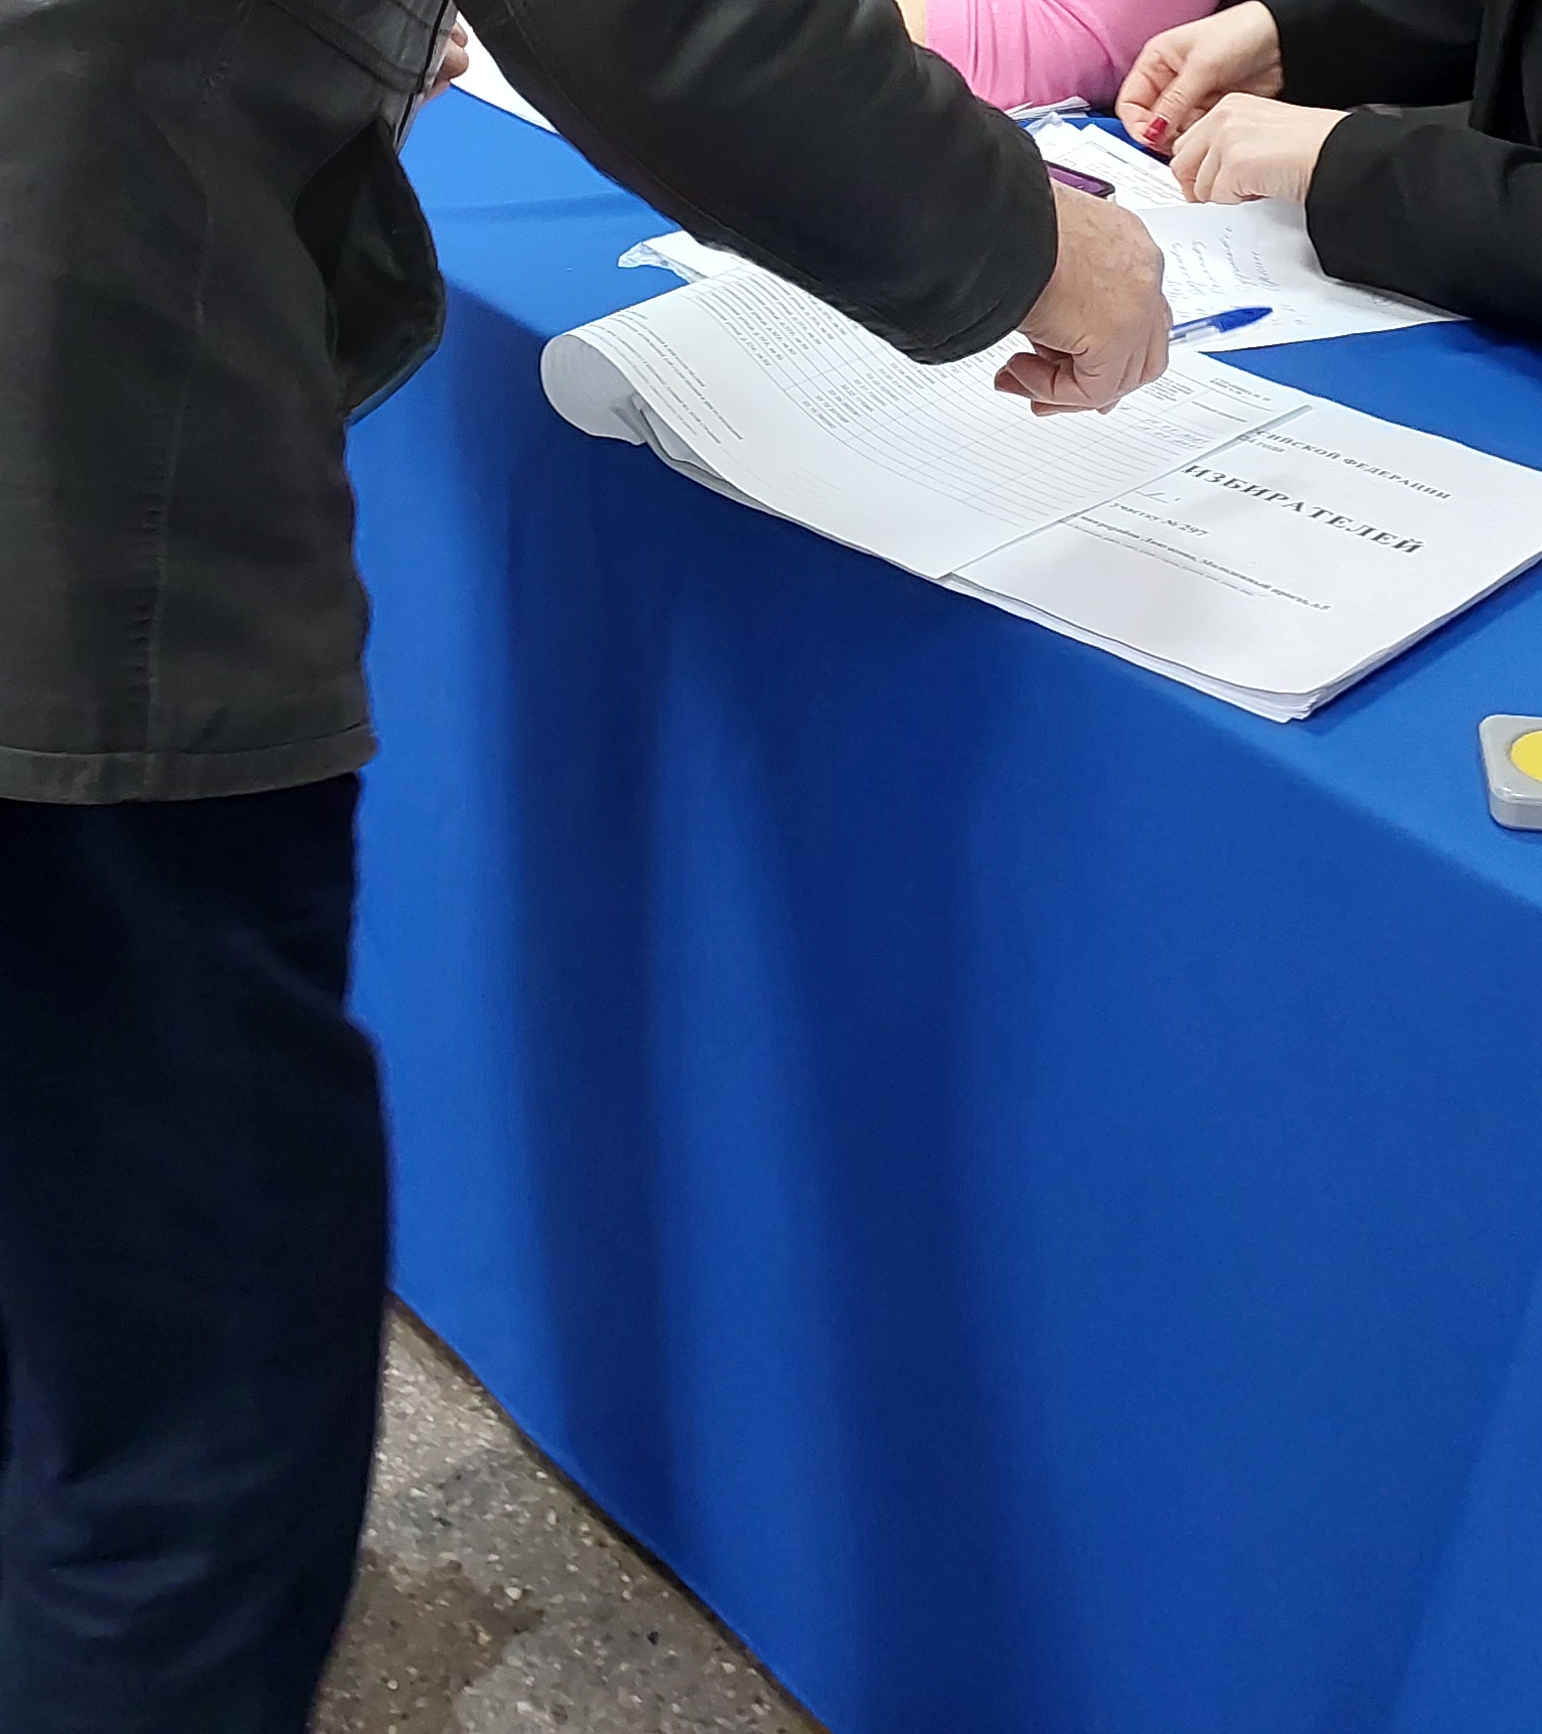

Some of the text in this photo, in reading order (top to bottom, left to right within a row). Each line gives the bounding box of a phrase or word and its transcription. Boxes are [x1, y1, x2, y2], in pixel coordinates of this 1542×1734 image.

[1256, 430, 1341, 460] СИЙСКОЙ
[1343, 457, 1452, 501] ФЕДЕРАЦИИ
[1180, 464, 1427, 555] ИЗБИРАТЕЛЕЙ
